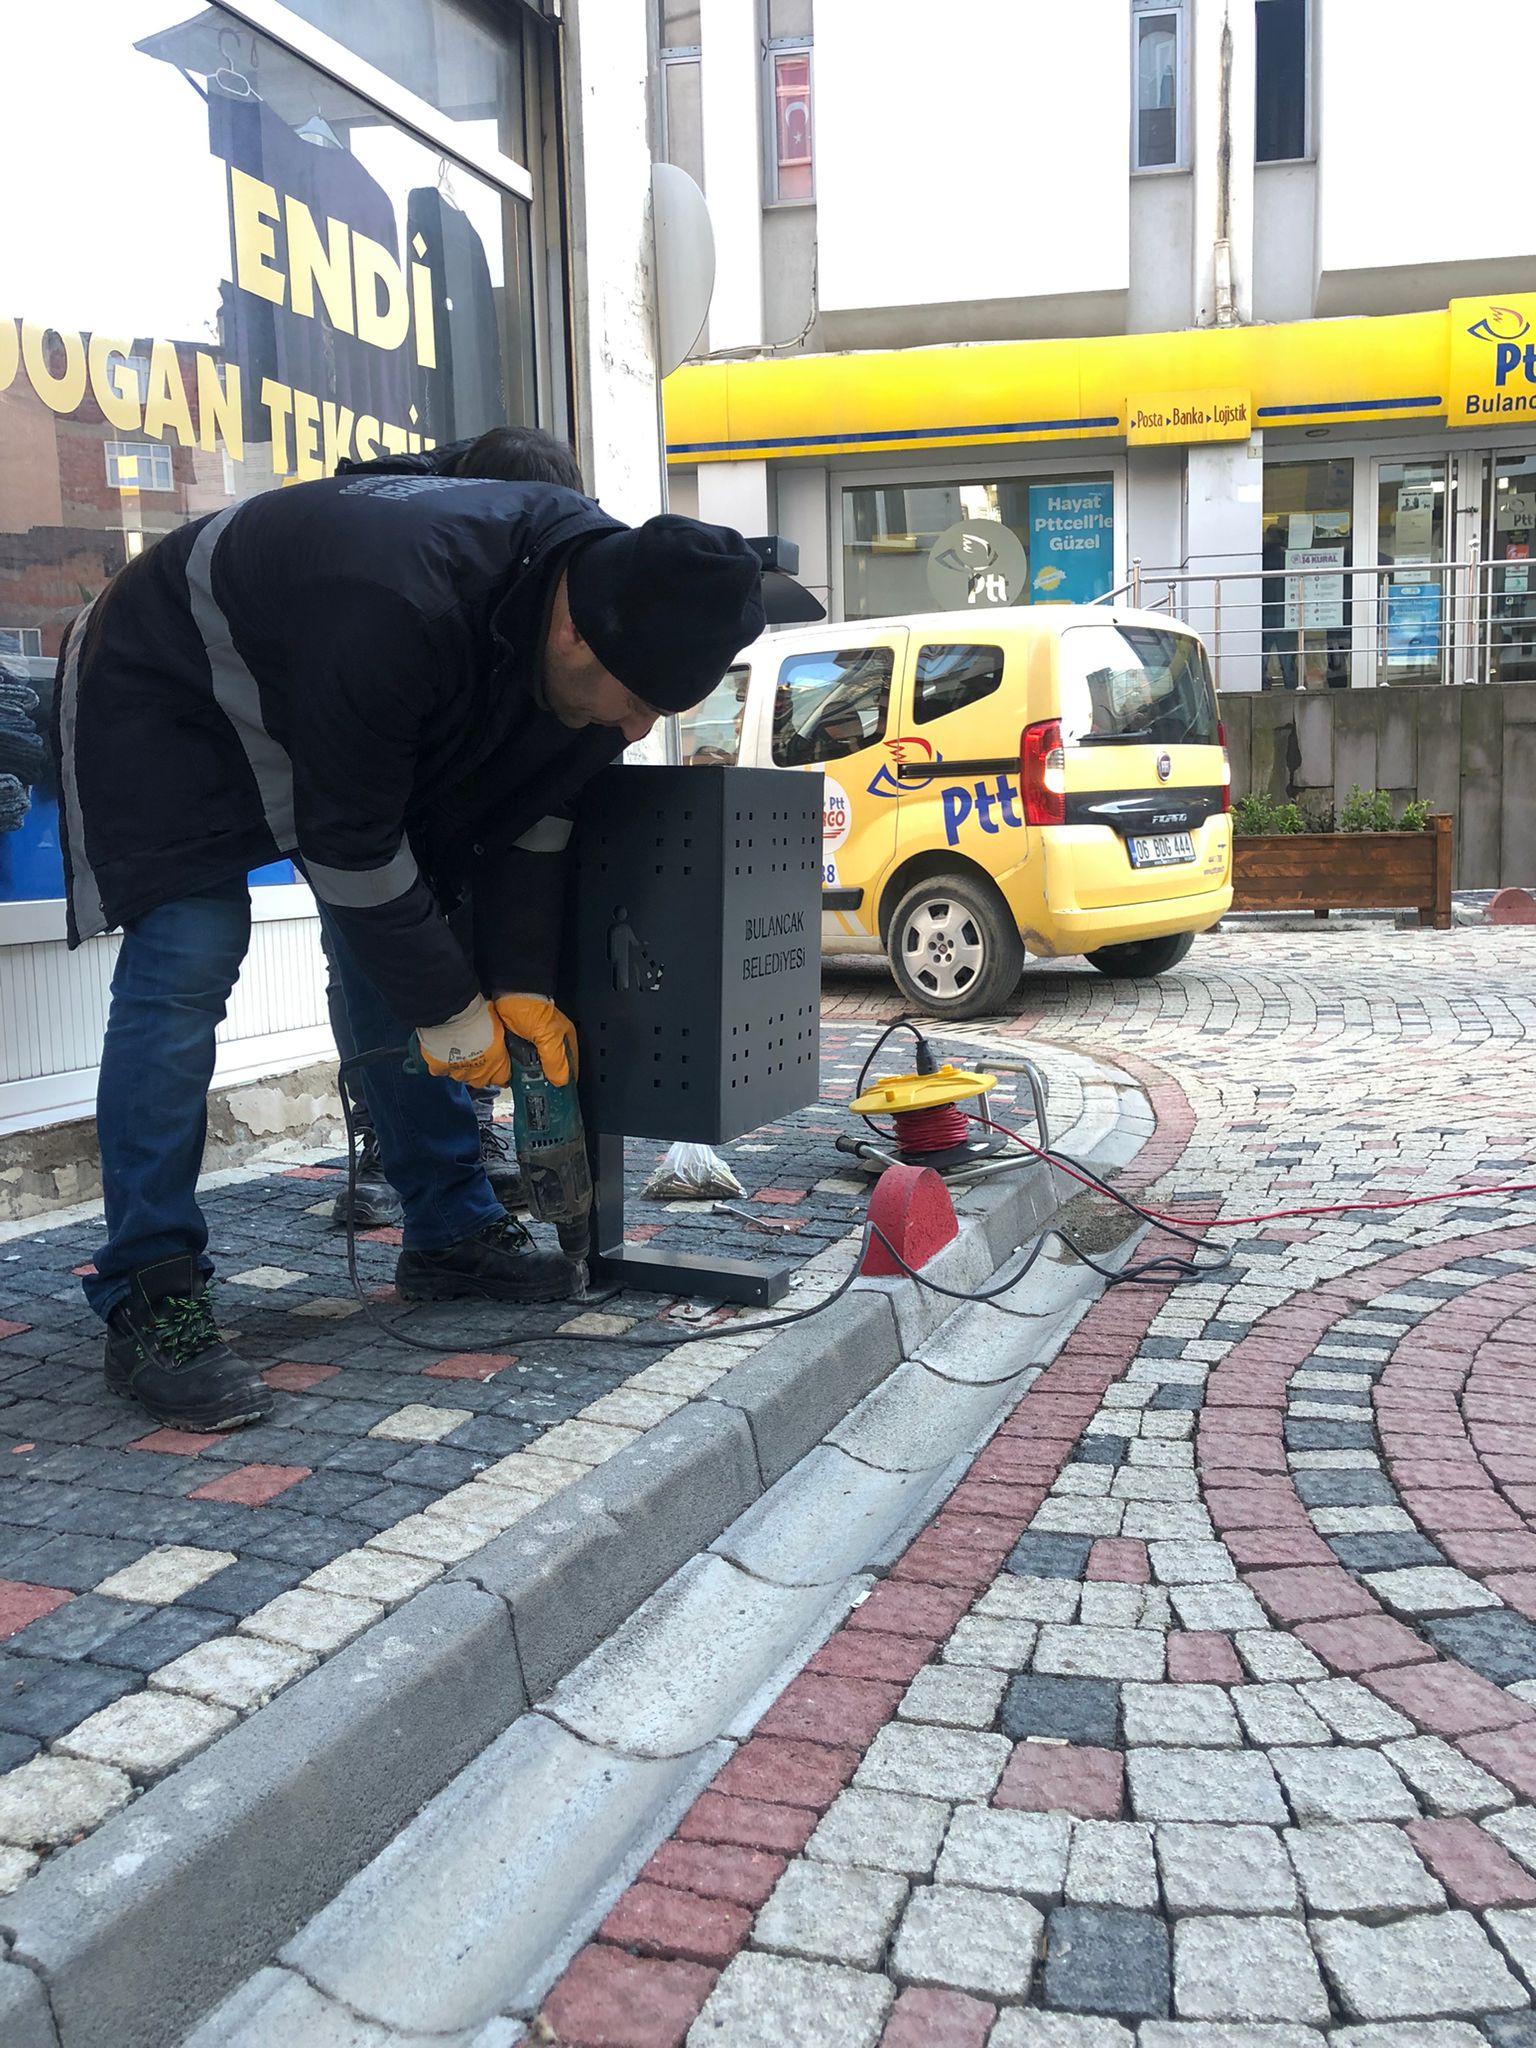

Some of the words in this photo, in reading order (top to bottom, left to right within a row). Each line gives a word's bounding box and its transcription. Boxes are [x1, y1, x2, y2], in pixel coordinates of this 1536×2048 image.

[1137, 410, 1163, 428] Posta
[1172, 406, 1204, 426] Banka
[1213, 403, 1247, 426] Lojistik
[261, 376, 436, 481] TEKS
[1047, 495, 1102, 513] Hayat
[1034, 515, 1113, 532] Pttcell'le
[1513, 513, 1533, 527] Ptt
[1049, 534, 1100, 551] Güzel
[967, 572, 1008, 604] Ptt
[829, 796, 845, 811] Ptt
[940, 774, 1022, 847] Ptt
[1136, 840, 1150, 860] 06
[1153, 837, 1172, 858] BDG
[1174, 836, 1191, 854] 444
[745, 911, 804, 941] BULANCAK
[743, 947, 805, 981] BELEDİYESİ
